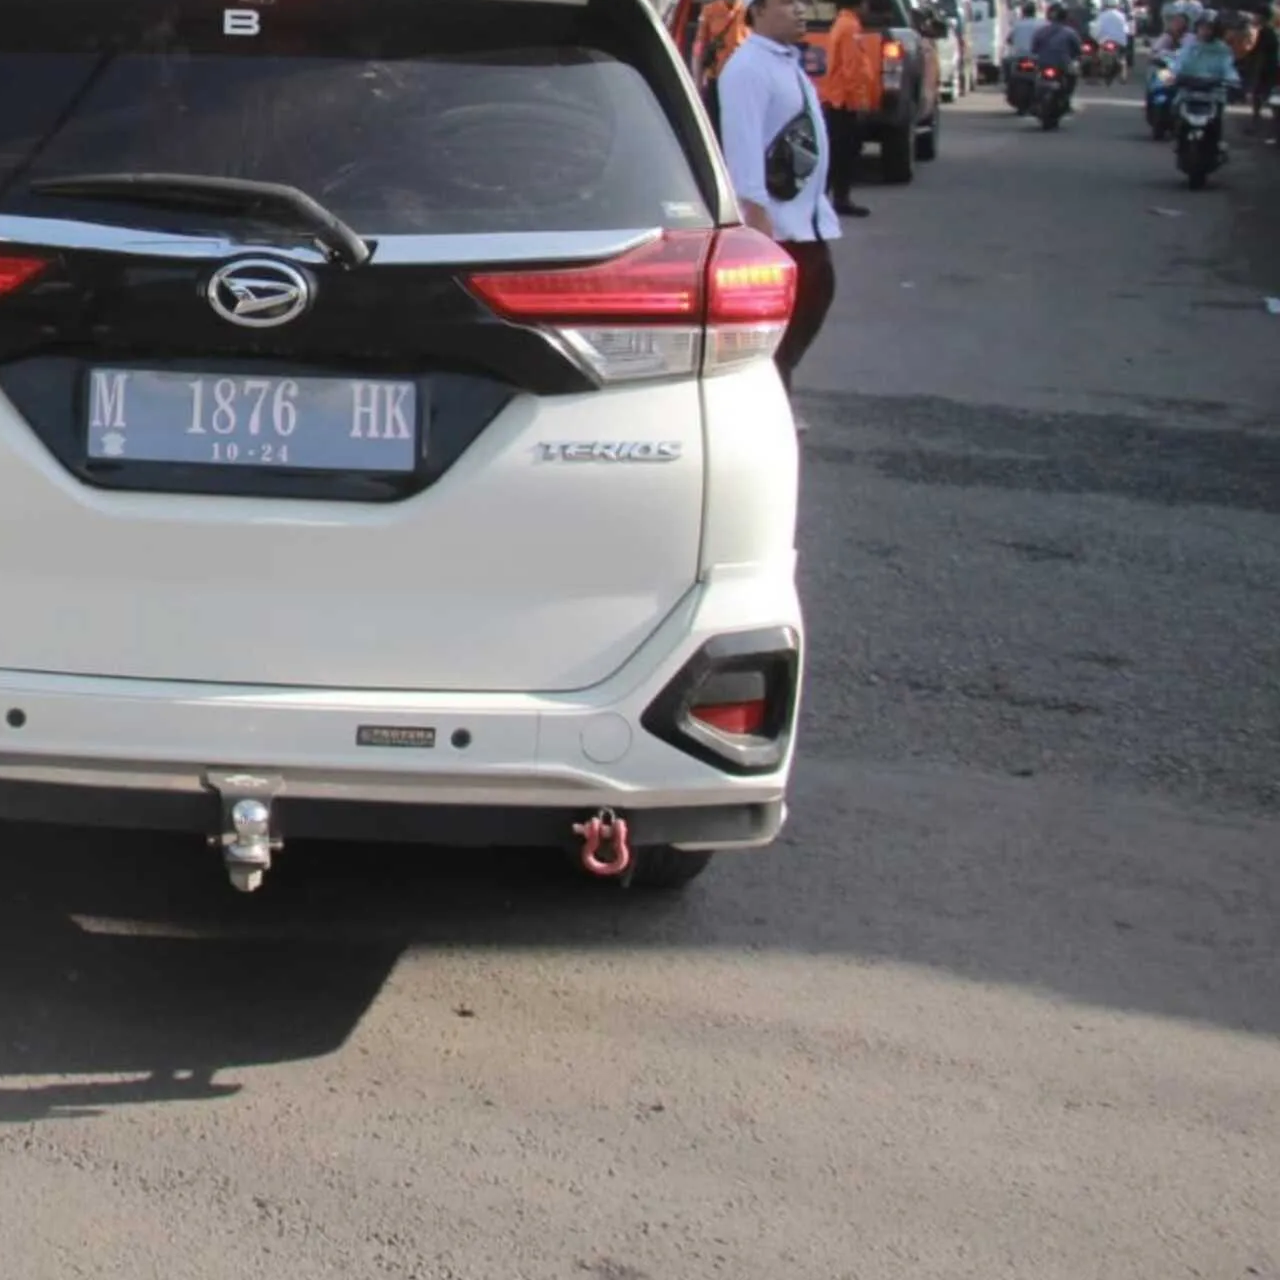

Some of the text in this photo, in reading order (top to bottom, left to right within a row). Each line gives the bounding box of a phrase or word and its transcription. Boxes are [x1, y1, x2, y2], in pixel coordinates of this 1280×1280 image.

[223, 8, 261, 36] B
[91, 372, 415, 439] M 1876 HK
[536, 441, 683, 463] TERIOS
